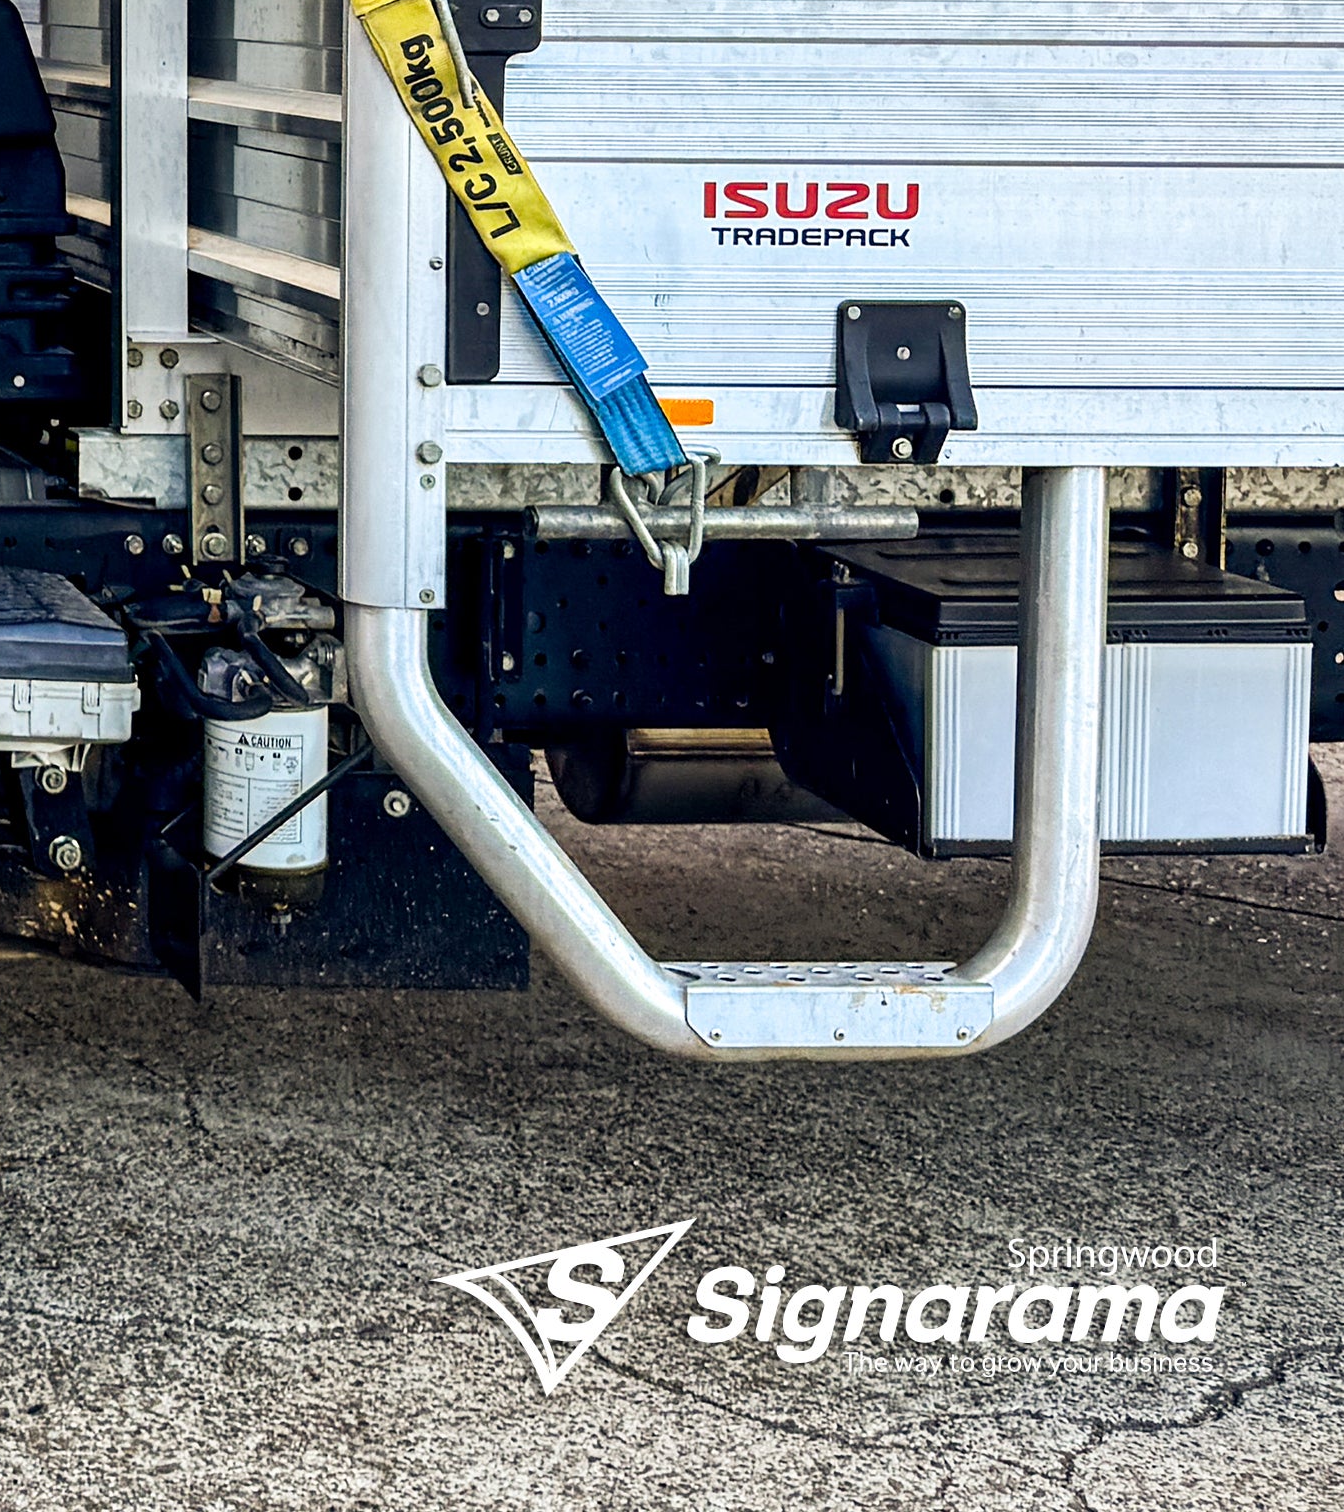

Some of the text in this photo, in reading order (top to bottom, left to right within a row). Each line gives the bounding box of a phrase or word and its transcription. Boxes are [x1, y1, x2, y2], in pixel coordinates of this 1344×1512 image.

[400, 34, 521, 239] L/C 2,500kg
[704, 182, 919, 219] ISUZU
[711, 227, 911, 247] TRADEPACK
[251, 736, 292, 748] CAUTION
